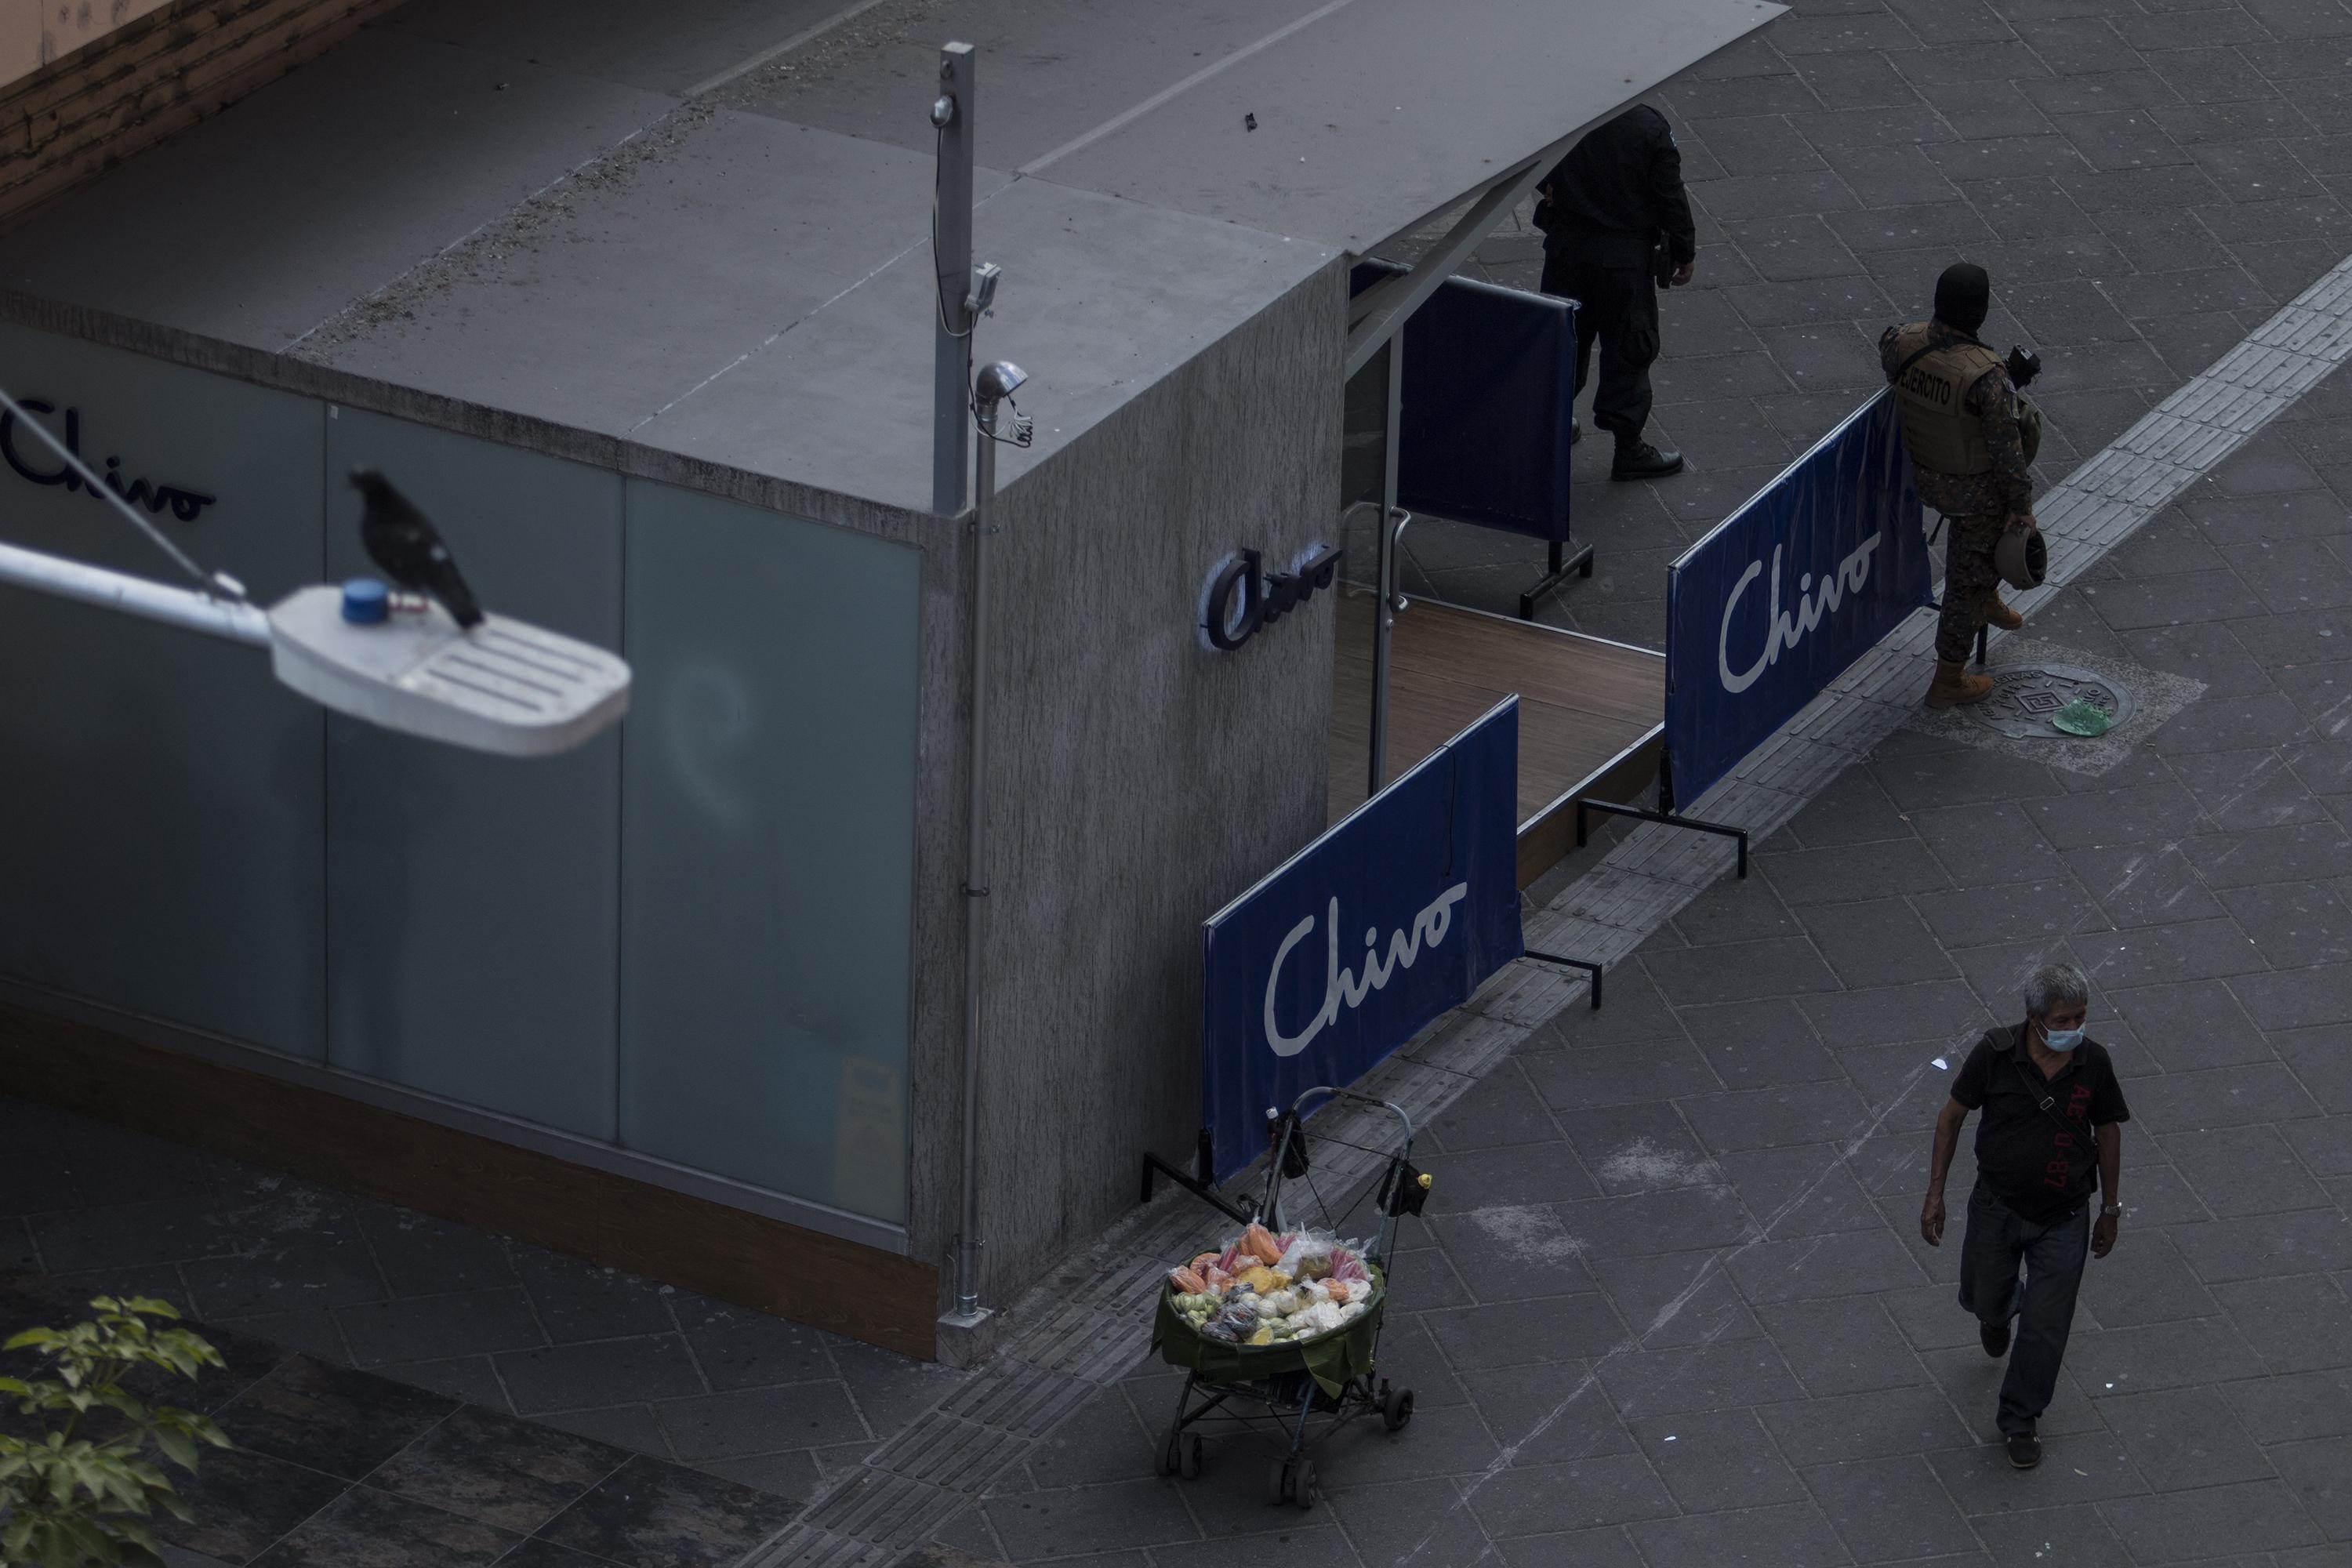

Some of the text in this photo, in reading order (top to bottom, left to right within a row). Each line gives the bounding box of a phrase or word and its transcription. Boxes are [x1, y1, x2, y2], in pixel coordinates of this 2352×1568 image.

[1900, 366, 1951, 405] EJERCITO
[1, 400, 216, 521] Chivo
[1719, 531, 1881, 693] Chivo
[1264, 882, 1467, 1057] Chivo
